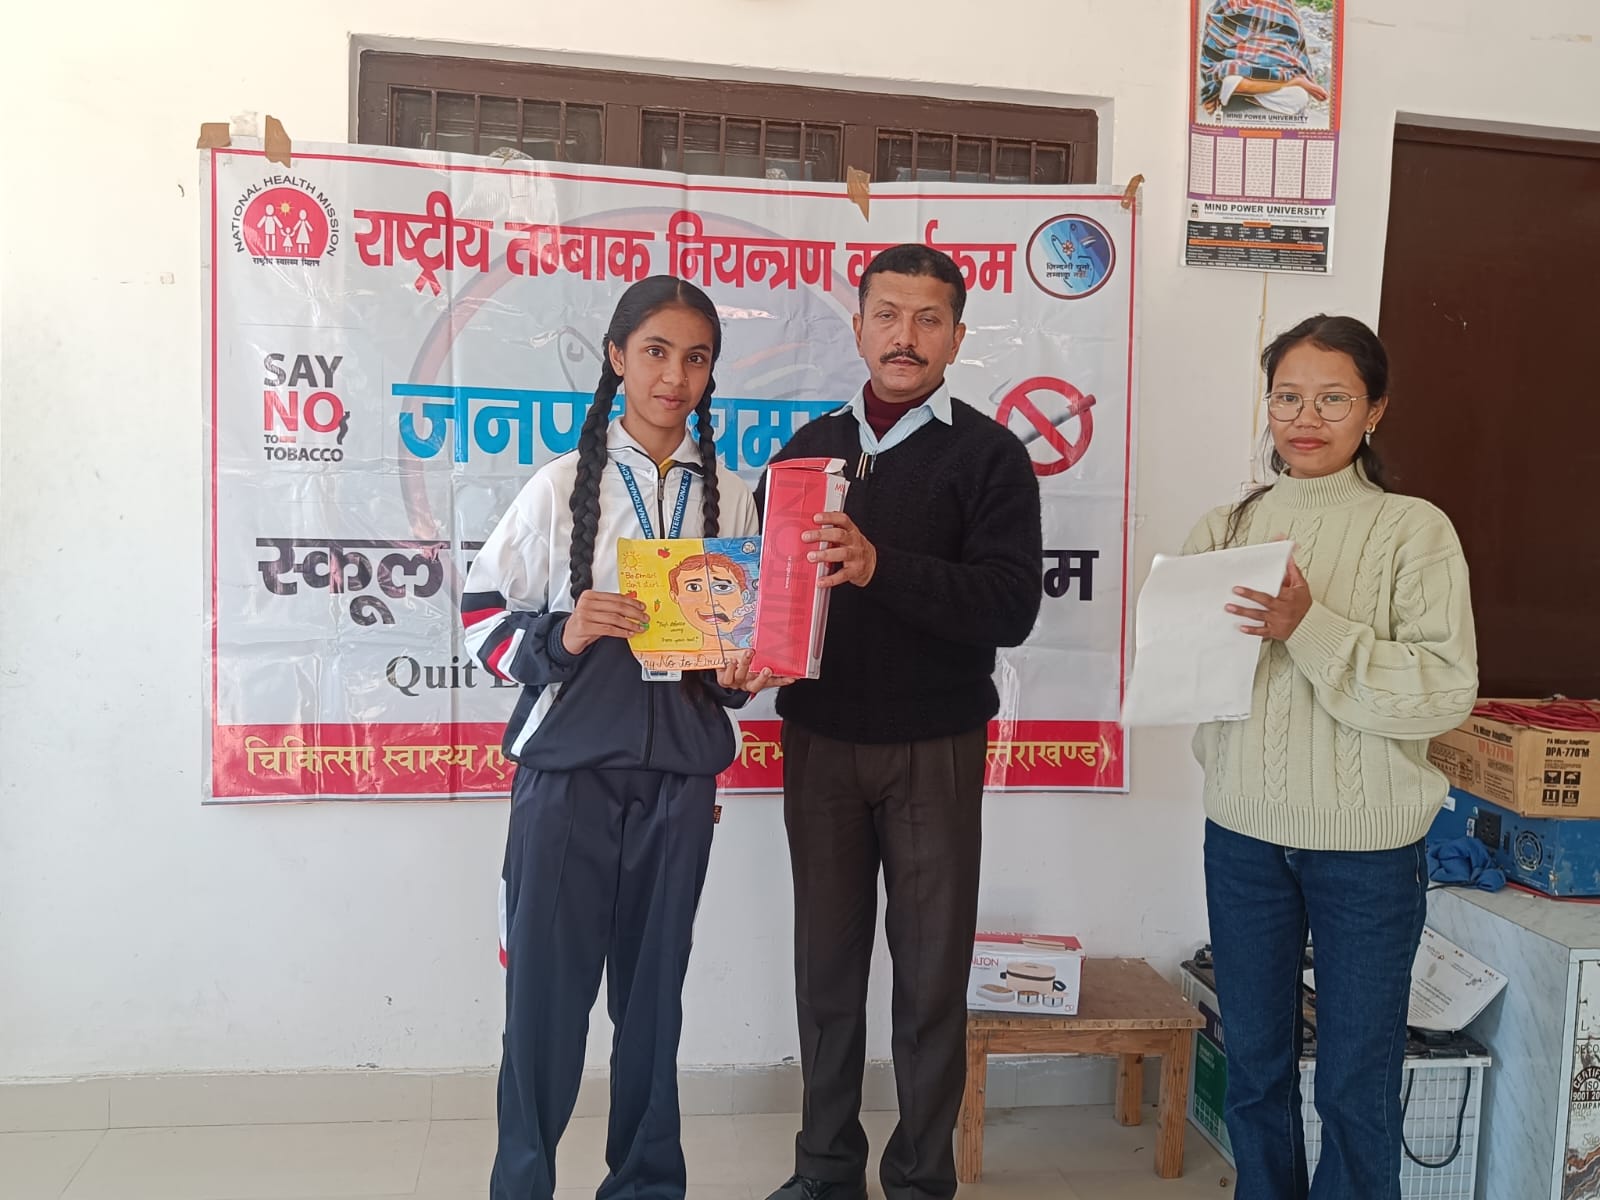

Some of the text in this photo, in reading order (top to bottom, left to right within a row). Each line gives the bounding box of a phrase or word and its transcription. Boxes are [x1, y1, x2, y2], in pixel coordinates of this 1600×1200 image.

[232, 175, 339, 257] NATIONAL HEALTH MISSION
[1204, 202, 1228, 212] MIND
[1231, 204, 1263, 213] POWER
[1267, 205, 1327, 216] UNIVERSITY
[353, 190, 494, 297] राष्ट्रीय
[666, 209, 836, 292] नियन्त्रण
[263, 353, 344, 388] SAY
[263, 390, 344, 433] NO
[392, 383, 626, 465] जनप
[263, 447, 344, 462] TOBACCO
[264, 434, 279, 444] TO
[670, 482, 689, 538] INTERNATIONAL
[256, 538, 451, 626] स्कूल
[386, 656, 478, 697] Quit
[244, 735, 376, 776] चिकित्सा
[381, 744, 478, 777] स्वास्थ्य
[1573, 1068, 1600, 1089] CERTIF
[1584, 1081, 1599, 1091] ISO
